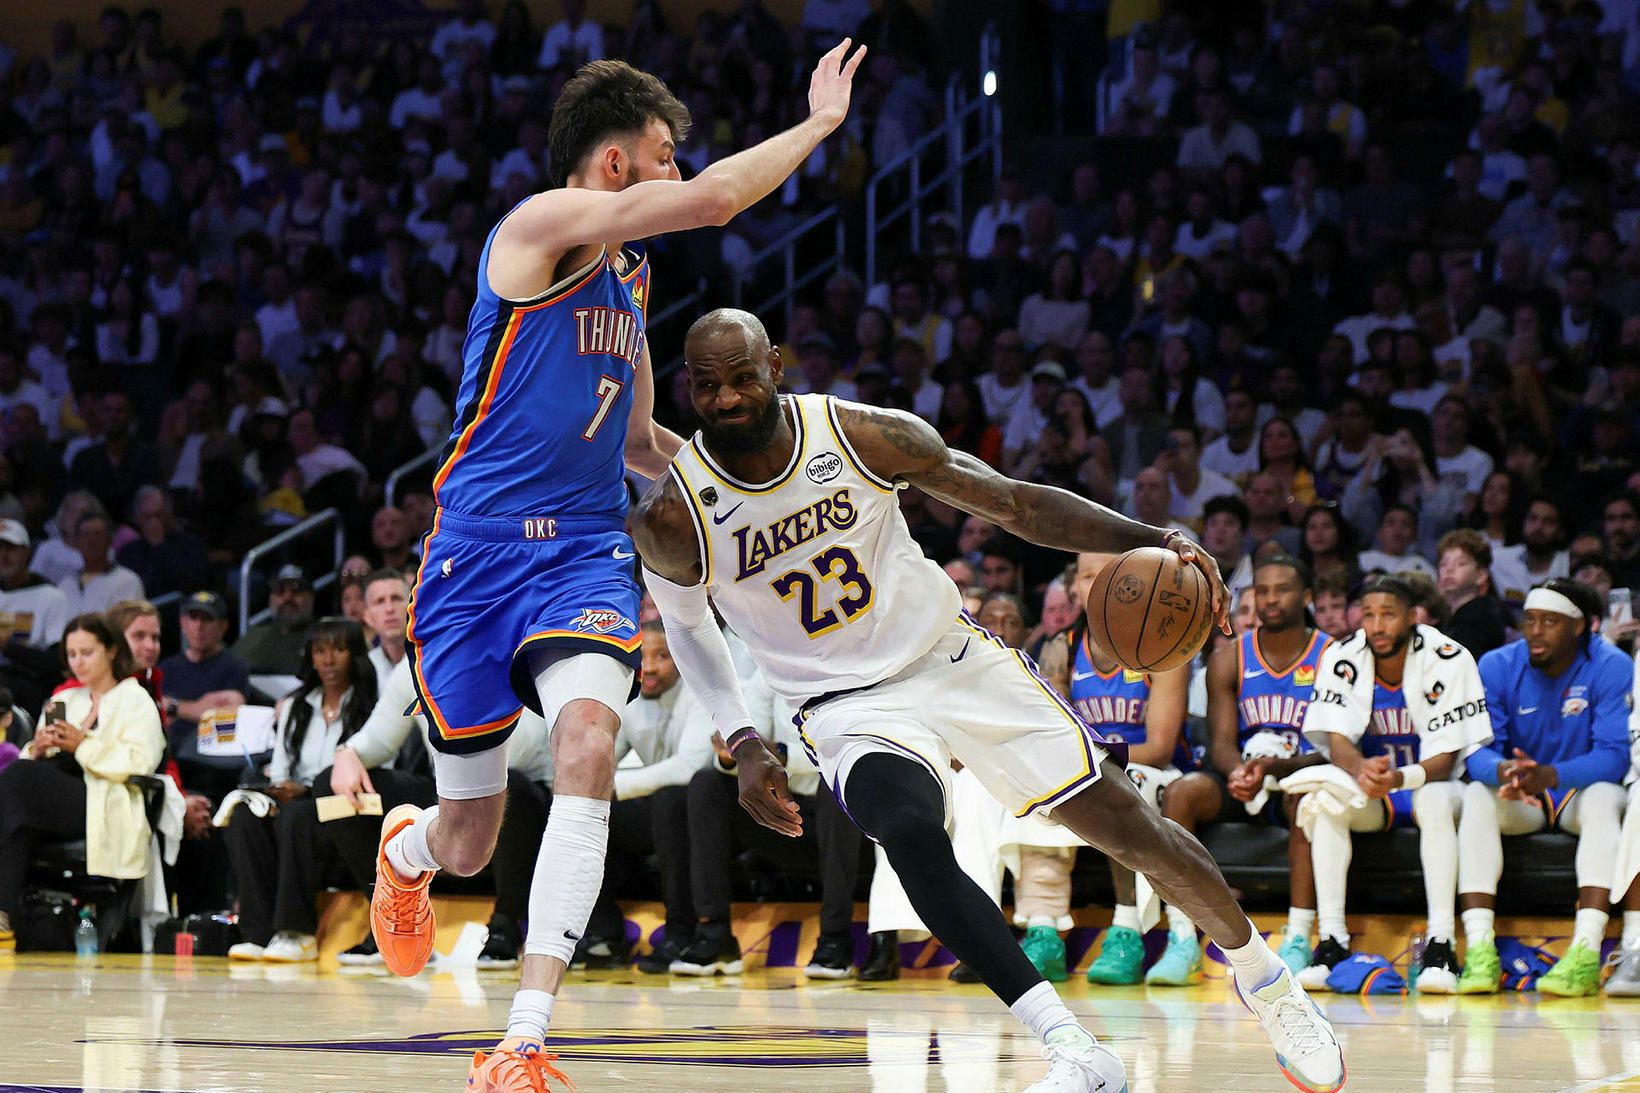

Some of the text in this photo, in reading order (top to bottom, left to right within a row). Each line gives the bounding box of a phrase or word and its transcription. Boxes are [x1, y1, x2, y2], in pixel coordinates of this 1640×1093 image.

[574, 306, 644, 374] THUNDE
[582, 374, 624, 442] 7
[808, 458, 840, 477] bibigo
[524, 518, 557, 539] OKC
[731, 488, 859, 584] LAKERS
[768, 543, 876, 640] 23
[1075, 695, 1149, 724] HUNDE
[1238, 694, 1310, 728] HUNDE
[1427, 698, 1488, 732] GATOR
